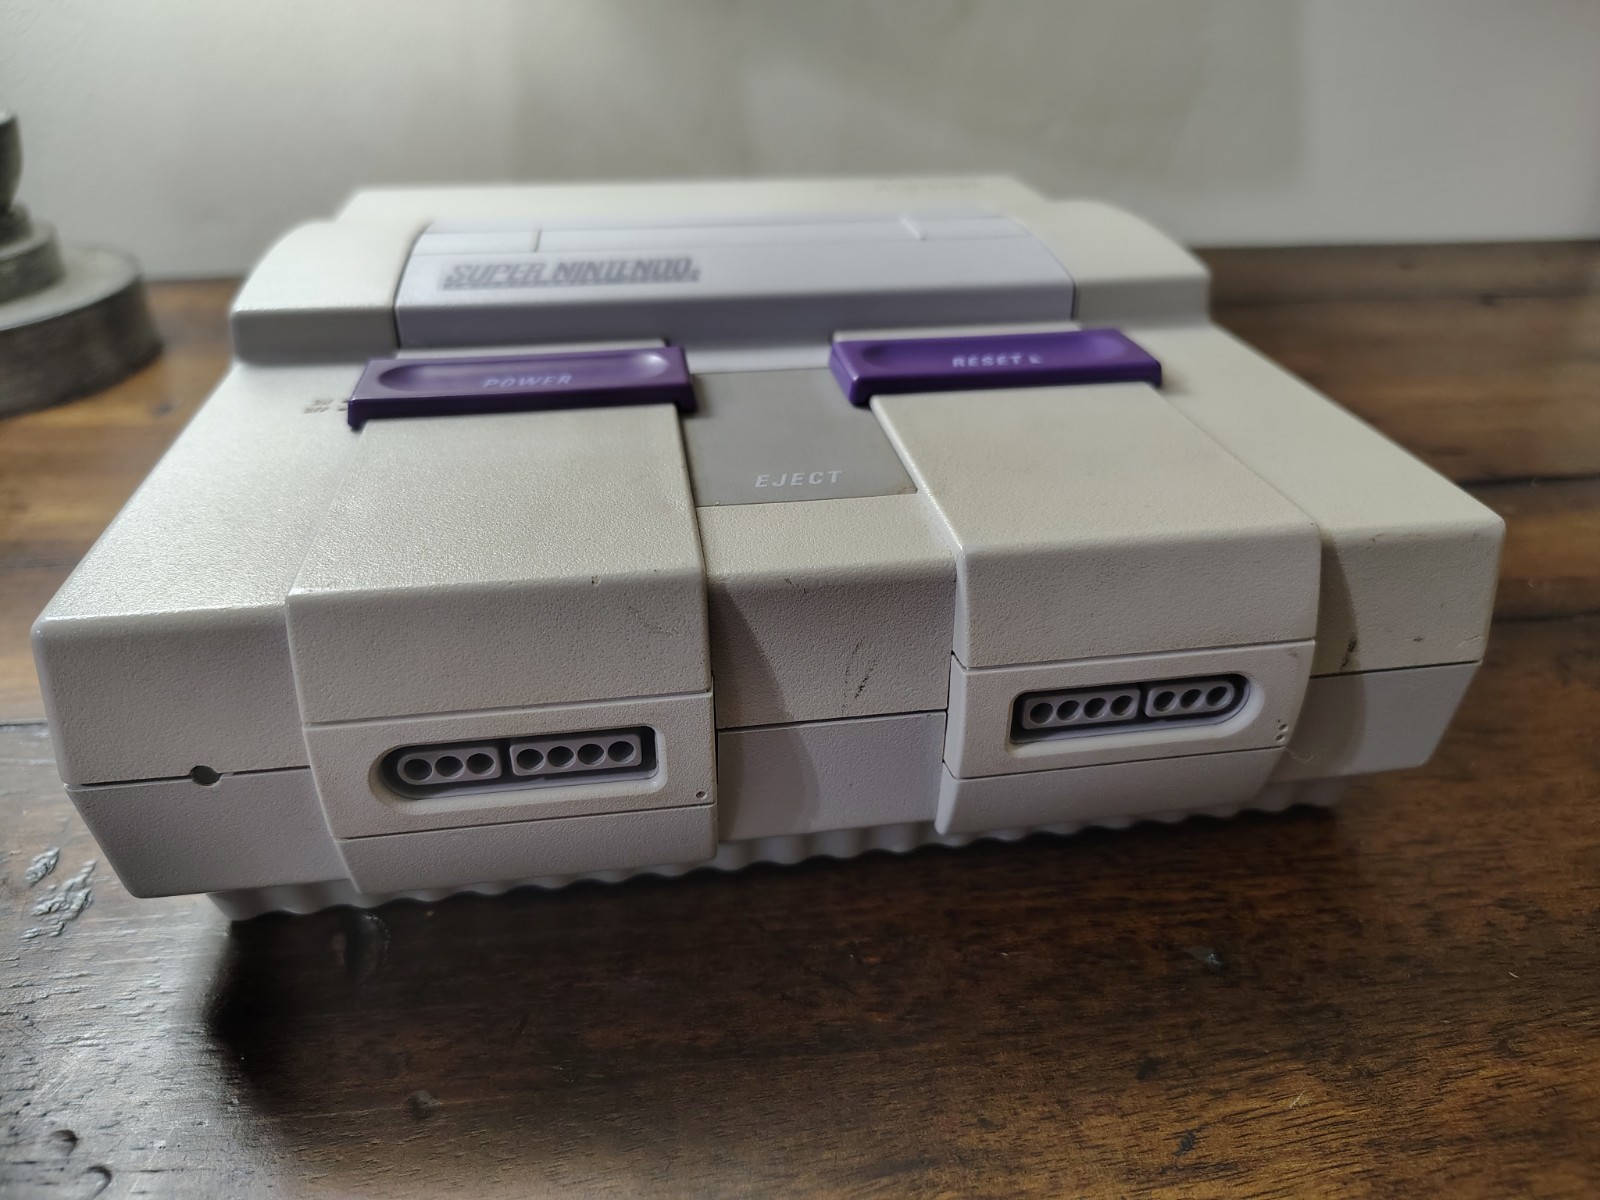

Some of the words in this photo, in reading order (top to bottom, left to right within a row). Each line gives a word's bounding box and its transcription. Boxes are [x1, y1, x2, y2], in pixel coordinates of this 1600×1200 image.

[448, 263, 547, 283] SUPER
[551, 257, 692, 282] NINTENDO
[952, 353, 1021, 367] RESET
[482, 374, 573, 388] POWER
[755, 470, 843, 488] EJECT
